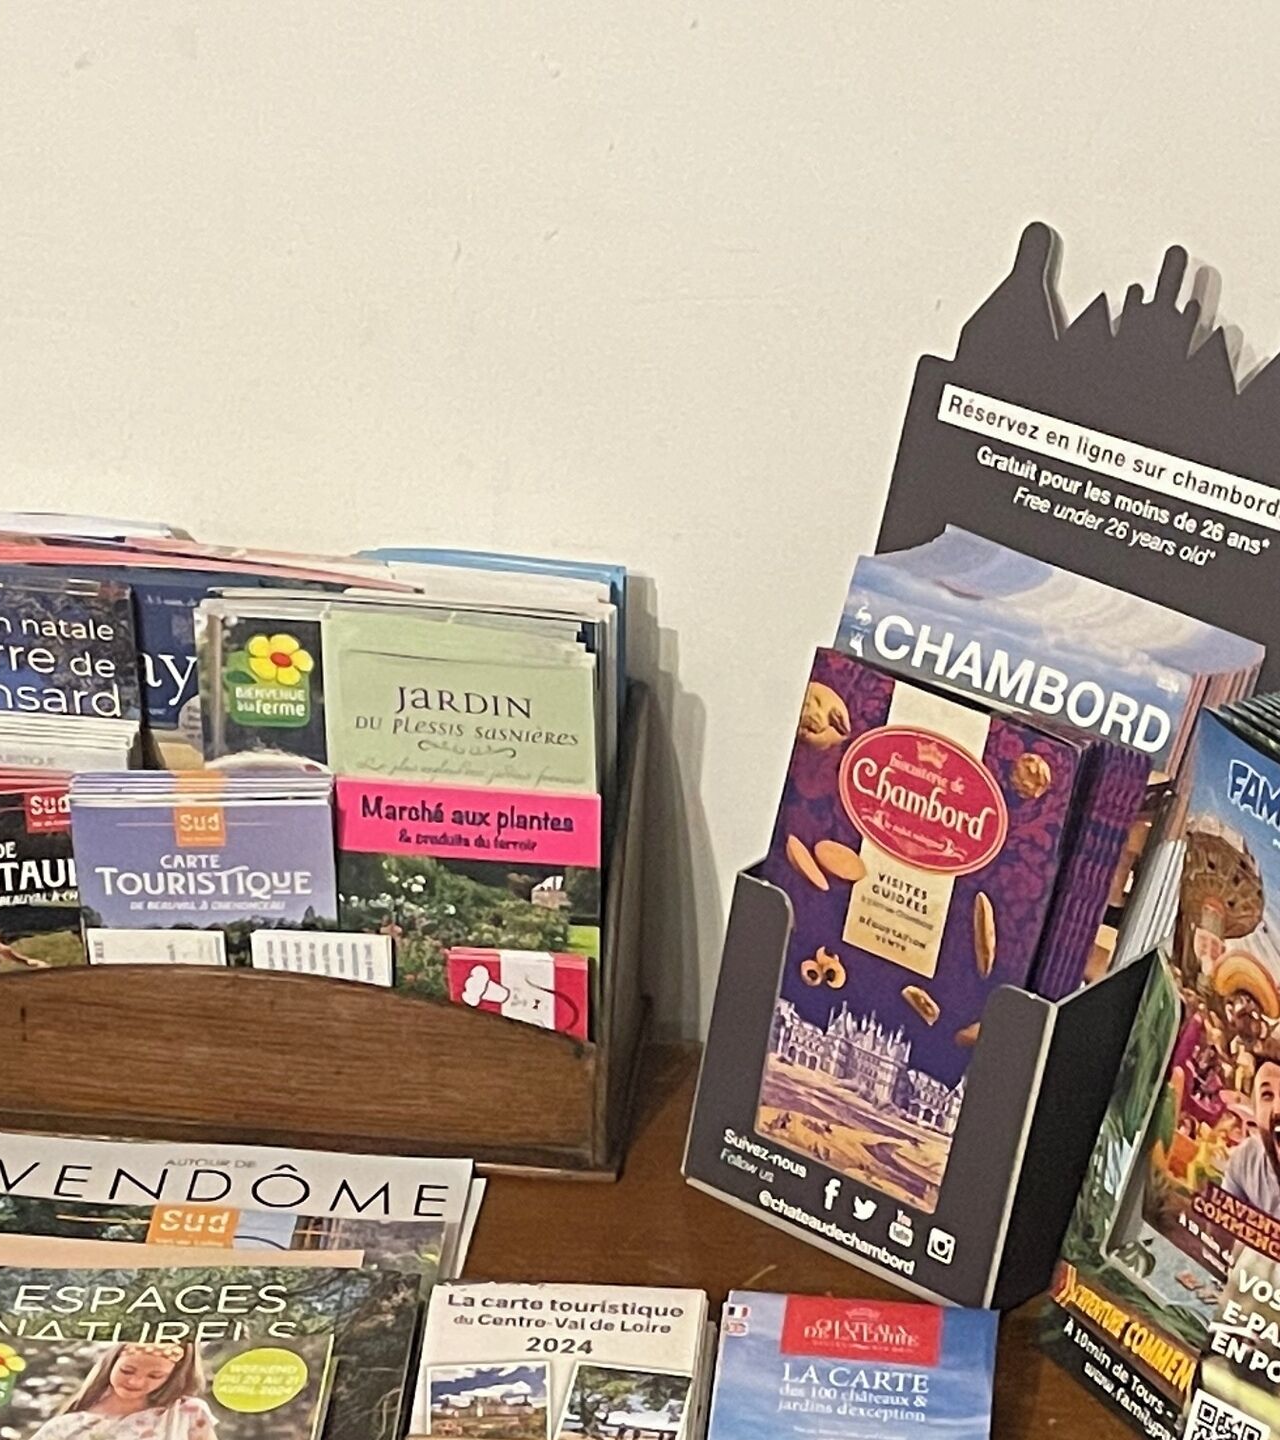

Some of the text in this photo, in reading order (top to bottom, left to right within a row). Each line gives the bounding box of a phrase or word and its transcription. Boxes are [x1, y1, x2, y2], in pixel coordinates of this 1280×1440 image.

[948, 395, 1039, 440] Réservez
[1046, 430, 1070, 449] en
[1077, 436, 1125, 466] ligne
[1133, 458, 1165, 480] sur
[976, 445, 1039, 481] Gratuit
[1039, 469, 1083, 495] pour
[1084, 480, 1111, 506] les
[1114, 494, 1170, 524] moins
[1173, 511, 1197, 533] de
[1200, 519, 1225, 542] 26
[1012, 486, 1051, 514] Free
[1053, 504, 1104, 532] under
[1104, 517, 1130, 540] 26
[1129, 529, 1176, 556] years
[22, 617, 114, 641] natale
[70, 651, 116, 678] de
[235, 687, 306, 702] BIENVENUE
[874, 615, 1170, 753] CHAMBORD
[254, 700, 306, 718] ferme
[355, 715, 382, 731] DU
[30, 794, 71, 816] Sud
[852, 757, 996, 842] Chambord
[180, 812, 221, 833] Sud
[361, 794, 575, 835] Marché aux plantes
[415, 830, 470, 850] produits
[474, 833, 491, 848] du
[493, 835, 538, 852] terroir
[160, 854, 220, 869] CARTE
[95, 865, 312, 900] TOURISTIQUE
[878, 872, 928, 900] VISITES
[130, 901, 145, 911] DE
[872, 883, 928, 915] GUIDÉES
[720, 1148, 775, 1184] Follow us
[724, 1128, 807, 1178] Suivez-nous
[160, 1209, 230, 1233] Sud
[758, 1190, 916, 1275] @chateaudechambord
[13, 1284, 289, 1315] ESPACES
[447, 1294, 684, 1318] La carte touristique
[453, 1314, 672, 1334] du Centre-Val de Loire
[525, 1337, 593, 1354] 2024
[1211, 1332, 1247, 1364] EN
[782, 1363, 930, 1393] LA CARTE
[1064, 1316, 1164, 1416] À 10min de Tours
[779, 1384, 928, 1408] des 100 châteaux &
[778, 1399, 926, 1423] jardins d'exception
